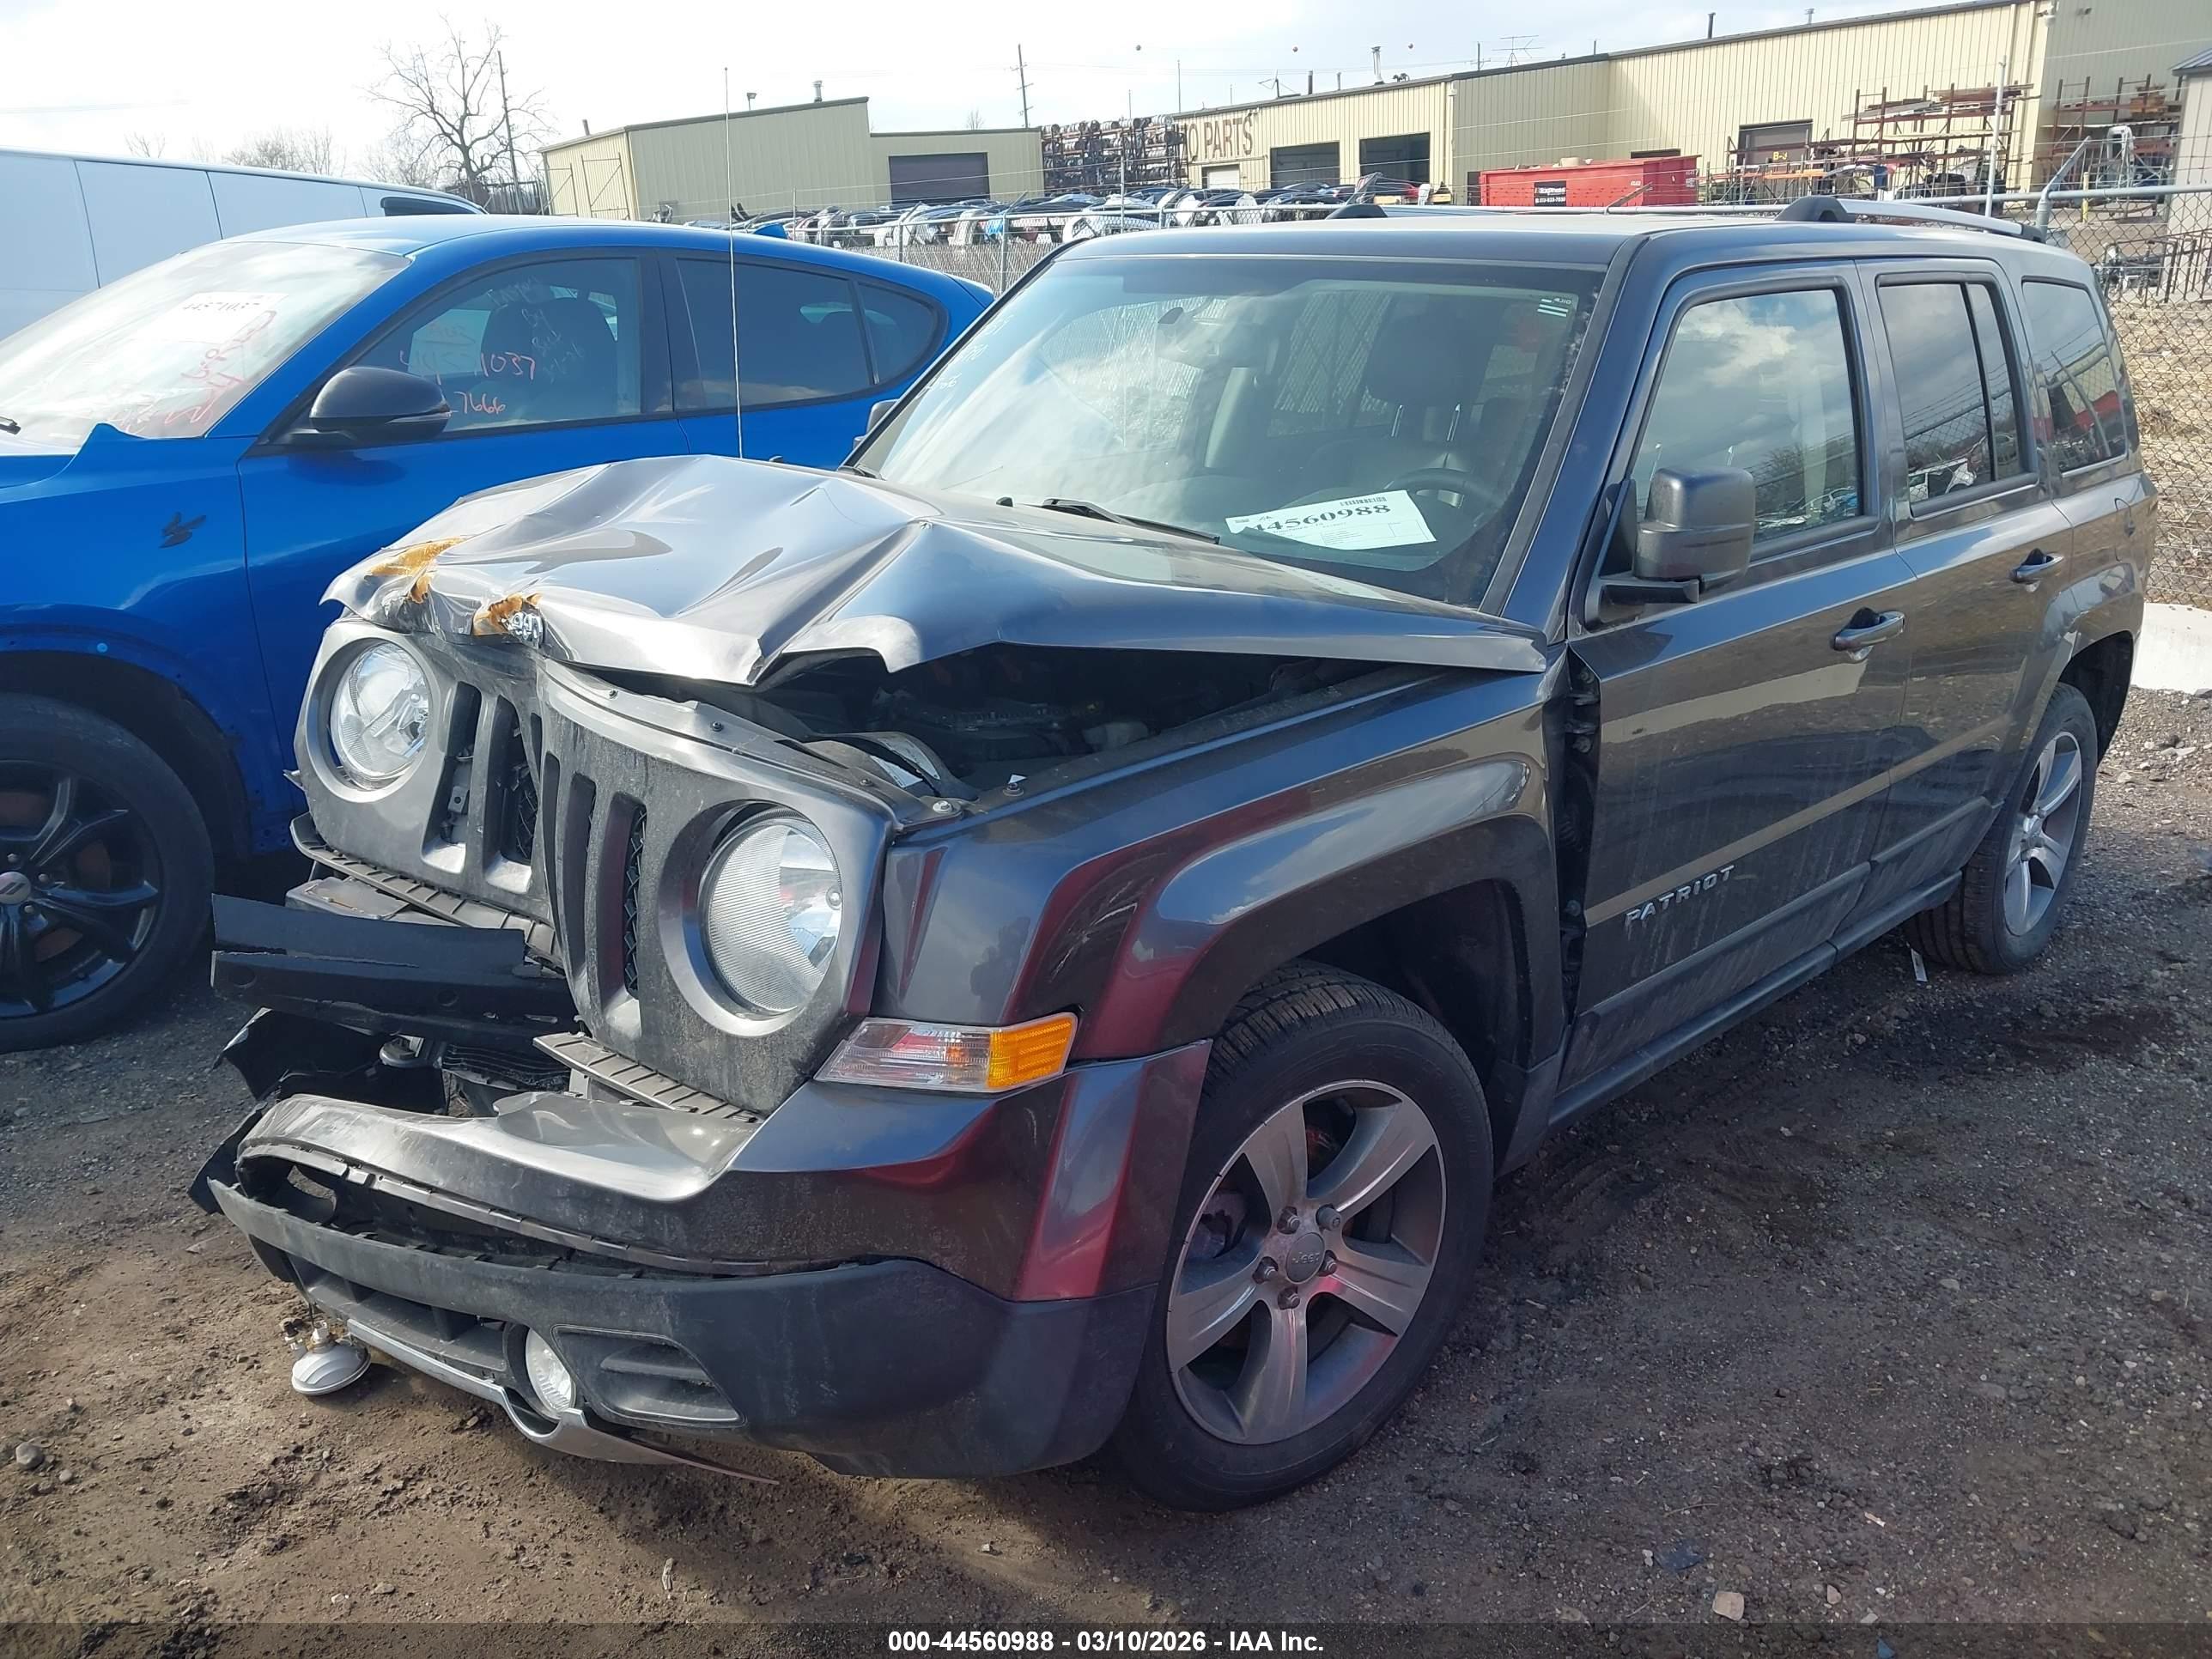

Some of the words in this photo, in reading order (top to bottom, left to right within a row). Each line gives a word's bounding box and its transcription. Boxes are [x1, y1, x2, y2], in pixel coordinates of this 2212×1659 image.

[1204, 113, 1253, 159] PARTS
[451, 391, 507, 415] 7666
[1626, 865, 1735, 928] PATRIOT
